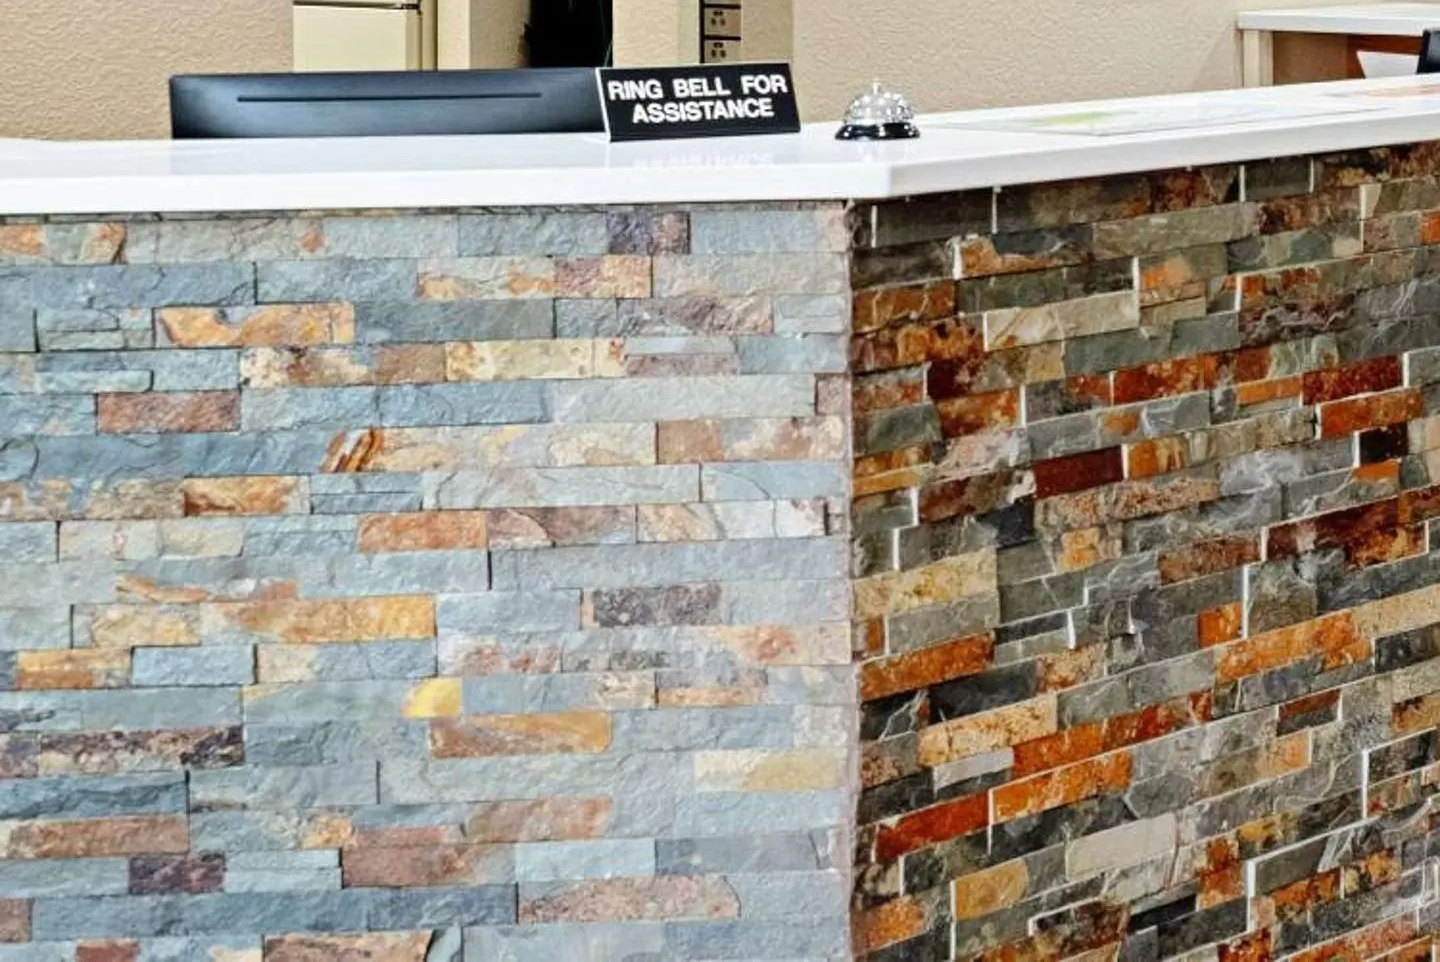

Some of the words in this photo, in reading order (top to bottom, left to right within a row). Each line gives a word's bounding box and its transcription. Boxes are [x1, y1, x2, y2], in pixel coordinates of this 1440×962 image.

[607, 77, 663, 101] RING
[672, 76, 731, 98] BELL
[741, 74, 788, 96] FOR
[632, 98, 775, 124] ASSISTANCE
